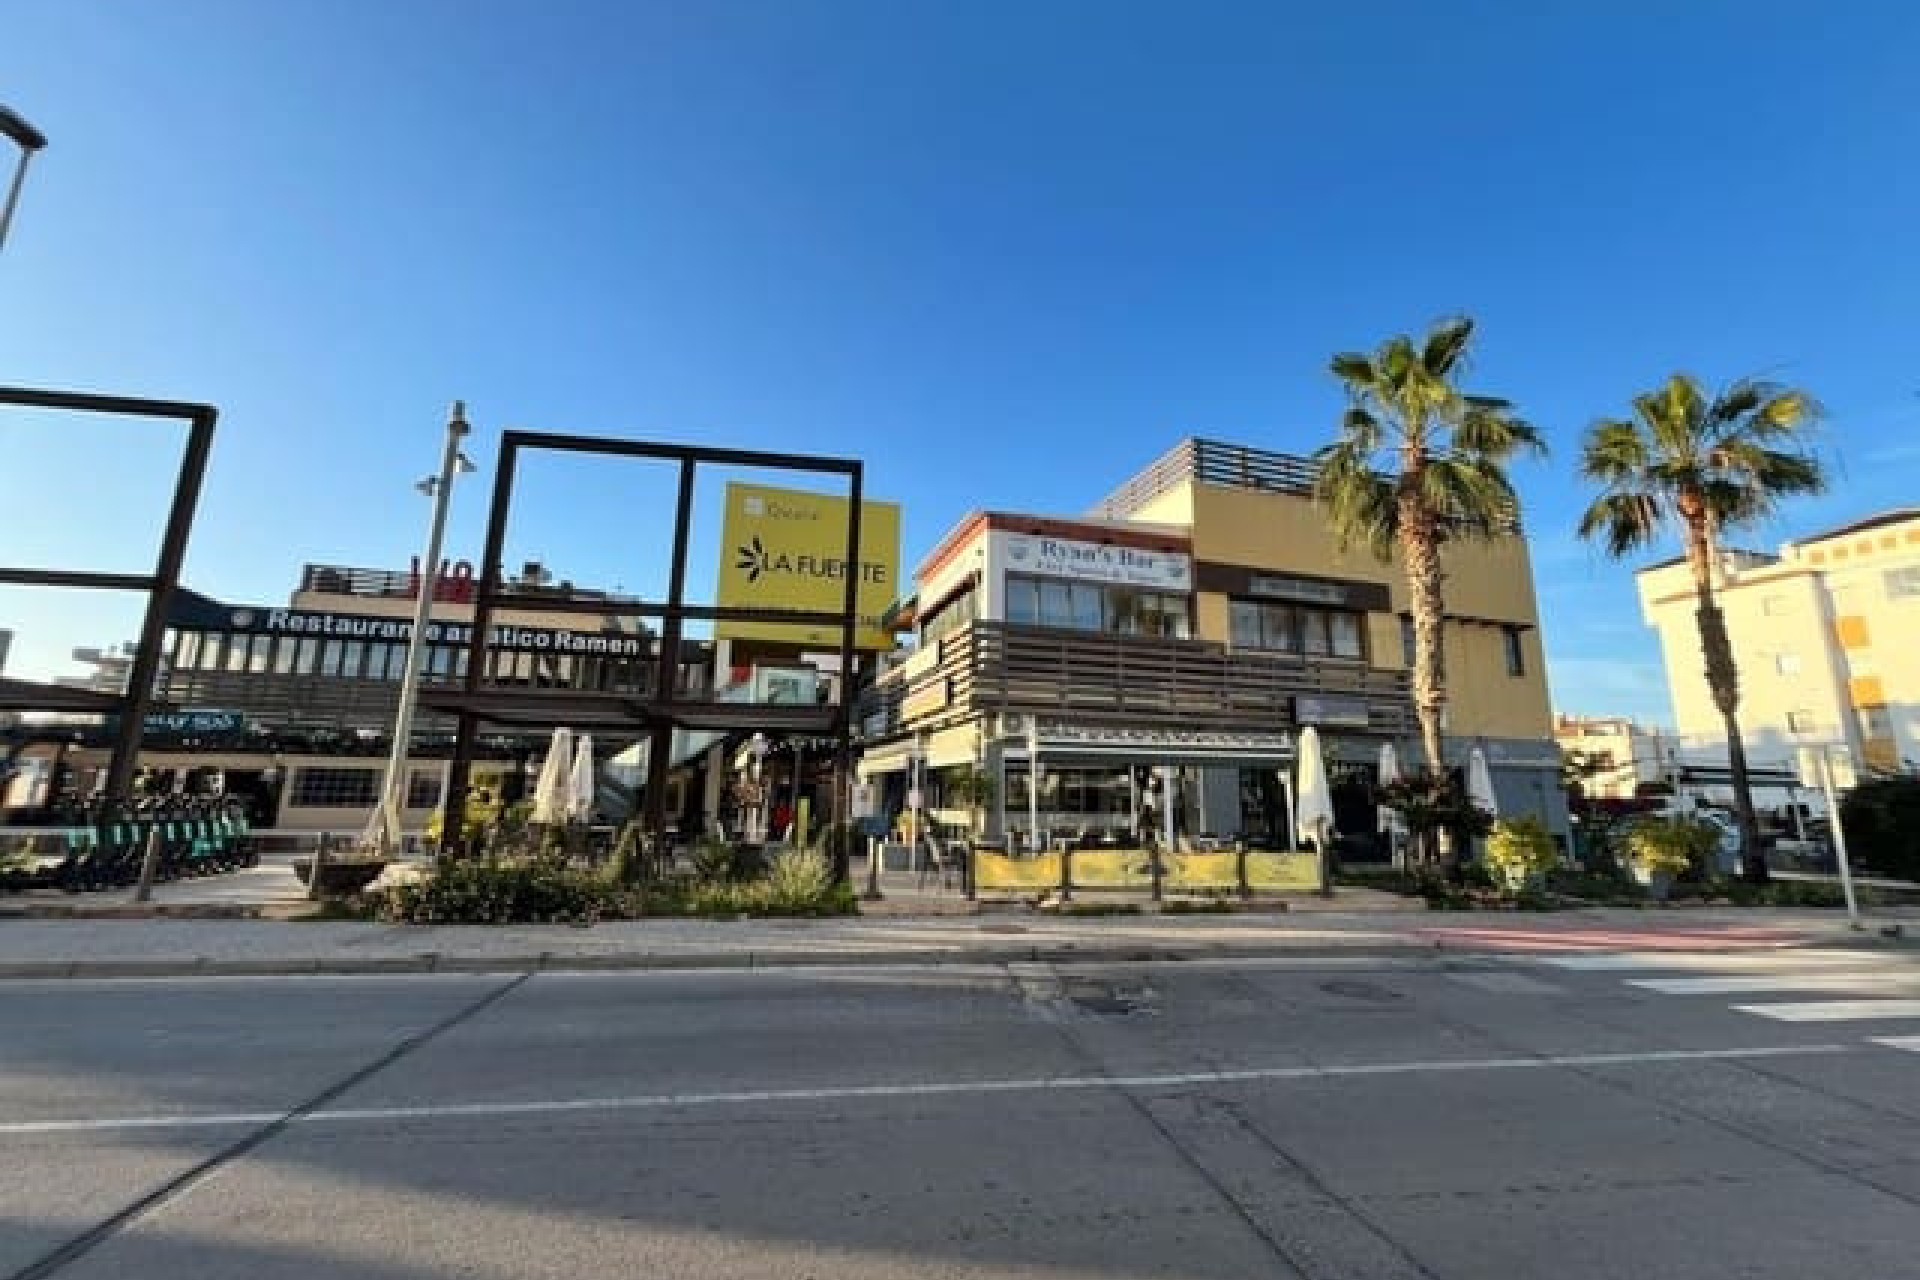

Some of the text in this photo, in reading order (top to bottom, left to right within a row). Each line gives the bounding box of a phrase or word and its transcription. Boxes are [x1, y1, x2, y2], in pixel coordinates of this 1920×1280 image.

[764, 552, 793, 573] LA
[1041, 540, 1153, 570] Ryan's Bar
[266, 610, 441, 642] Restaurane
[555, 631, 639, 656] Ramen
